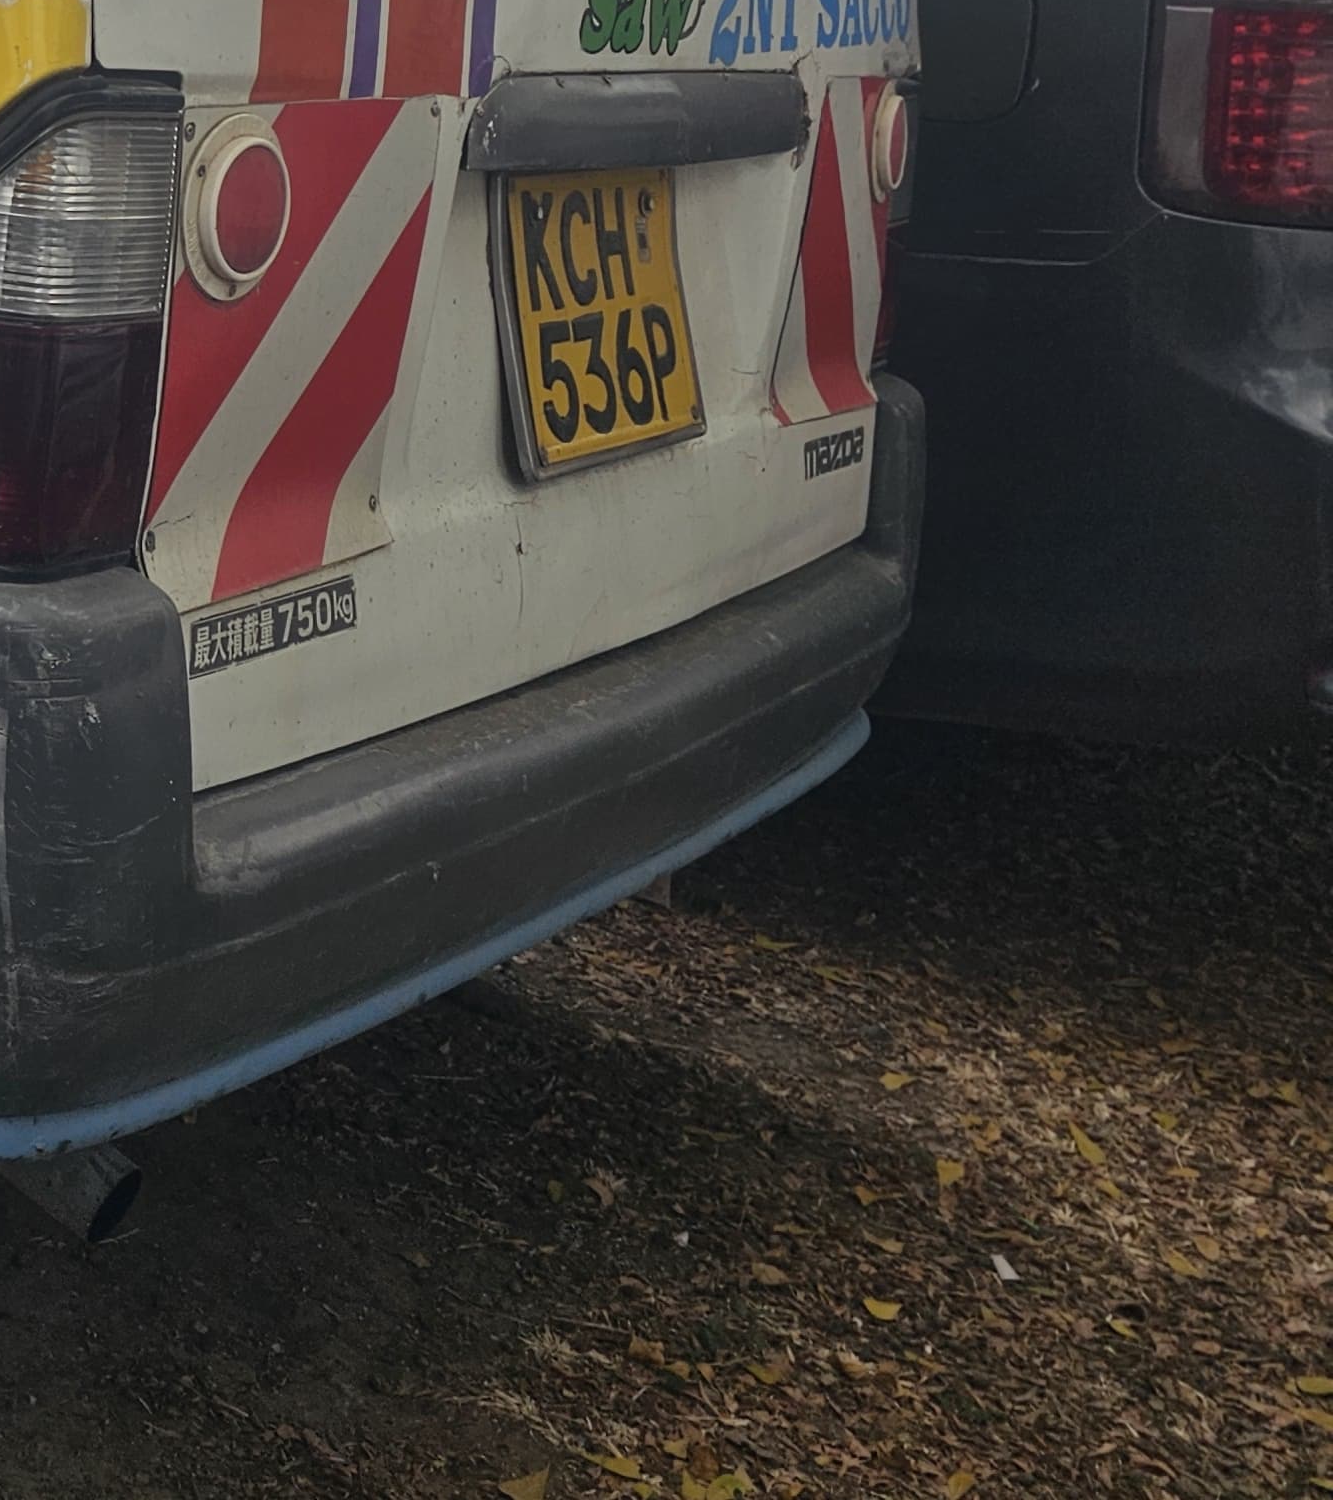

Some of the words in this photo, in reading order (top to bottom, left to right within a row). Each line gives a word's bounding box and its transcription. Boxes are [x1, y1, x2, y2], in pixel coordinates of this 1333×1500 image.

[520, 187, 636, 312] KCH
[539, 303, 677, 443] 536P
[193, 607, 275, 670] 最大積載量
[277, 589, 355, 644] 750kg
